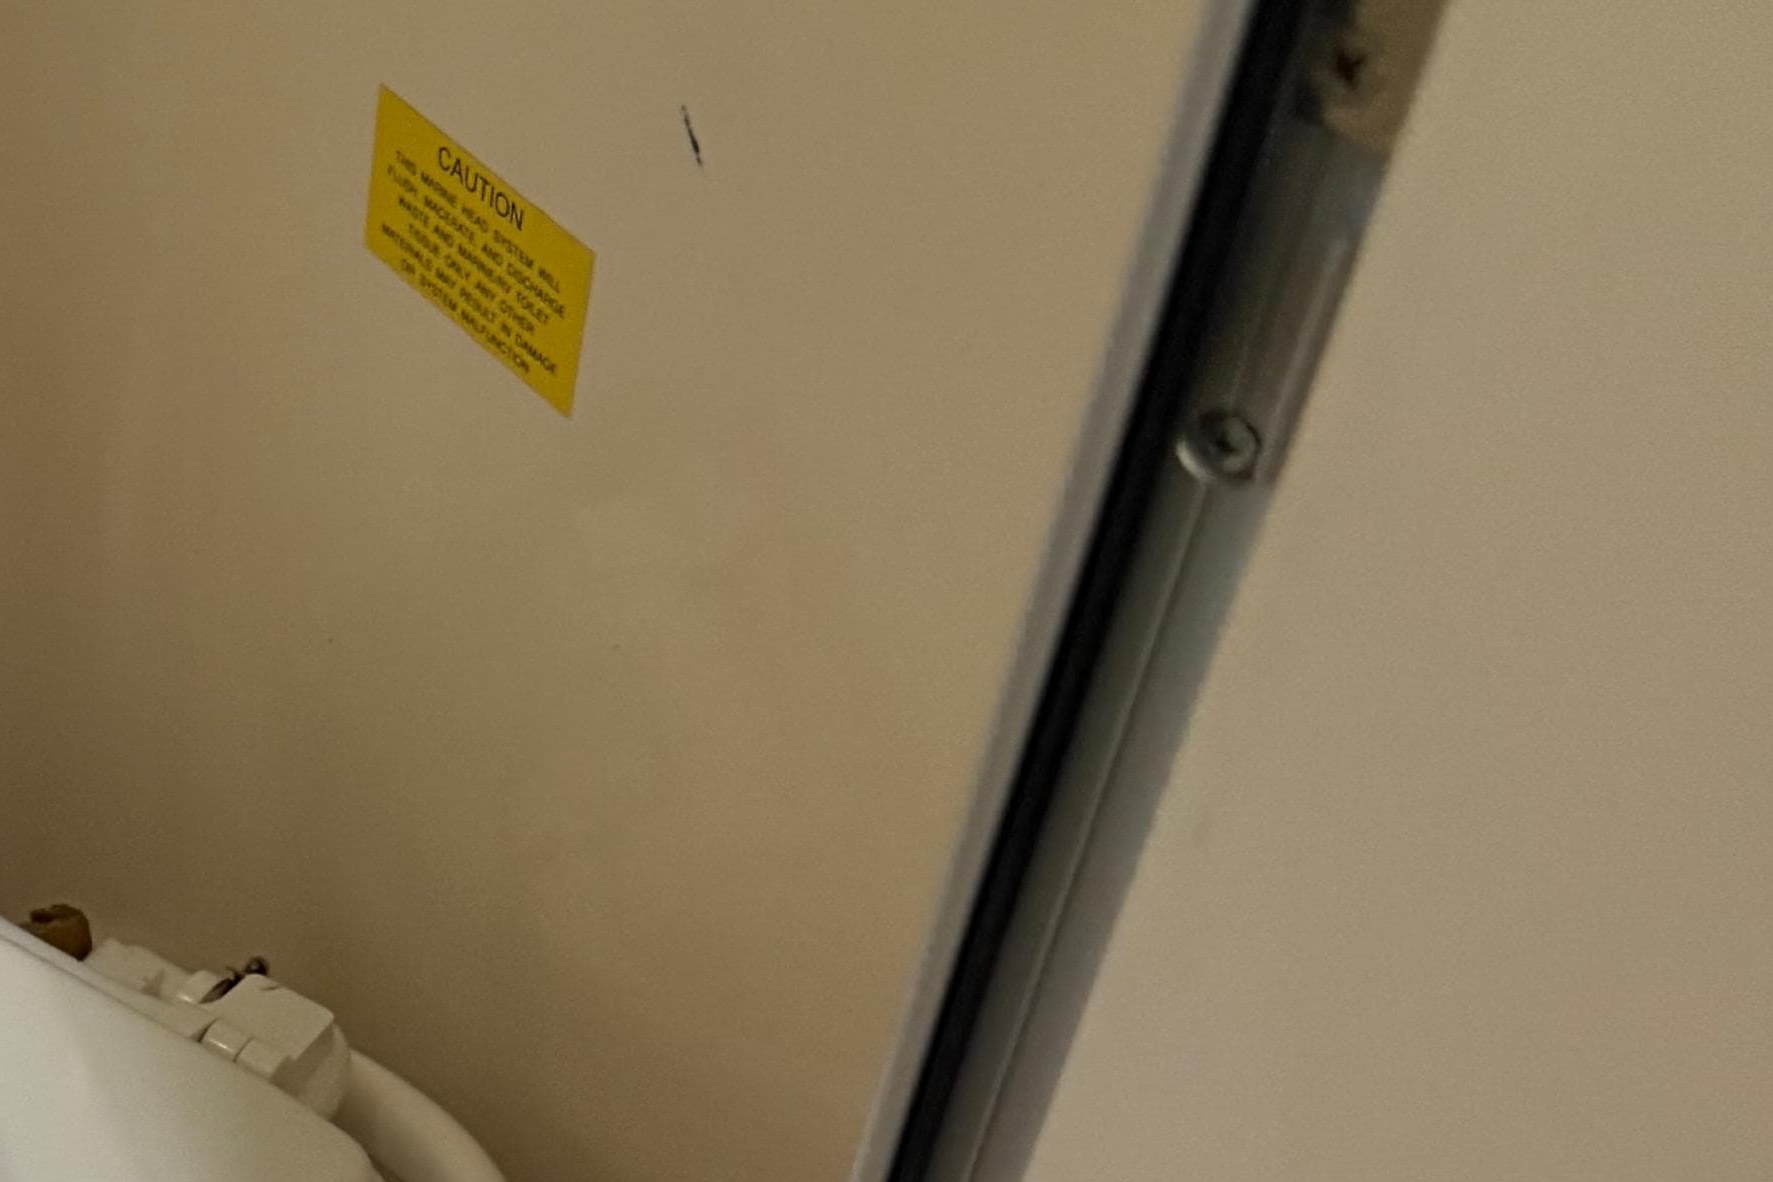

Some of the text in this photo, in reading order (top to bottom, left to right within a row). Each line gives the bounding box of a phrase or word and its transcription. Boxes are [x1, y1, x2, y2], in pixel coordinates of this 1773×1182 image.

[438, 146, 524, 231] CAUTION
[493, 227, 534, 271] SYSTEM
[515, 288, 549, 327] TOILET
[514, 330, 557, 375] DAMAGE
